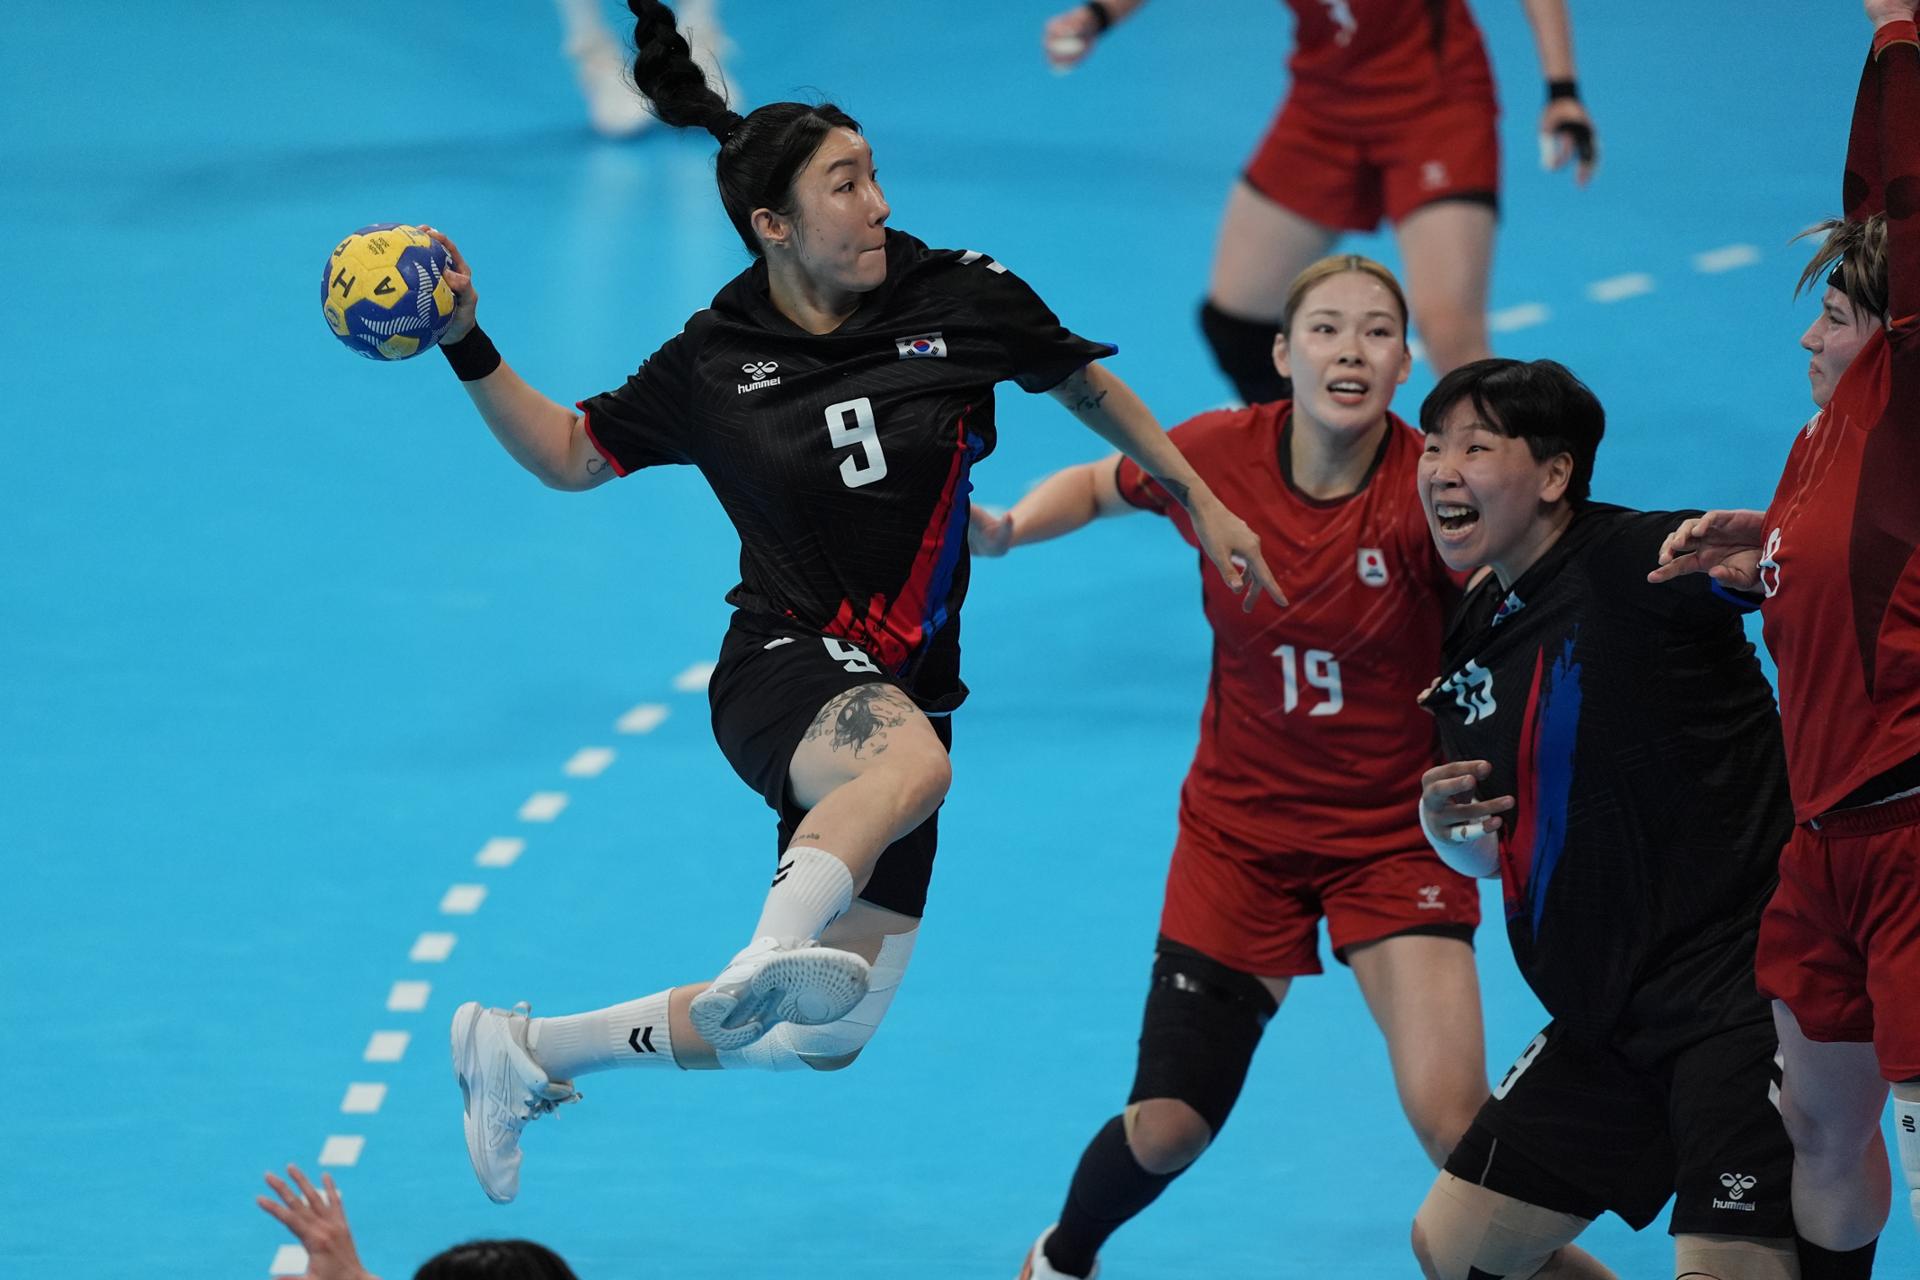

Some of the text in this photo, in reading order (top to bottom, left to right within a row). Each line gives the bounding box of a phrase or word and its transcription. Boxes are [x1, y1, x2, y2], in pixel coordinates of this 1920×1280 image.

[738, 376, 781, 394] hummel
[824, 397, 888, 488] 9
[1271, 644, 1344, 716] 19
[1712, 1197, 1756, 1212] hummel
